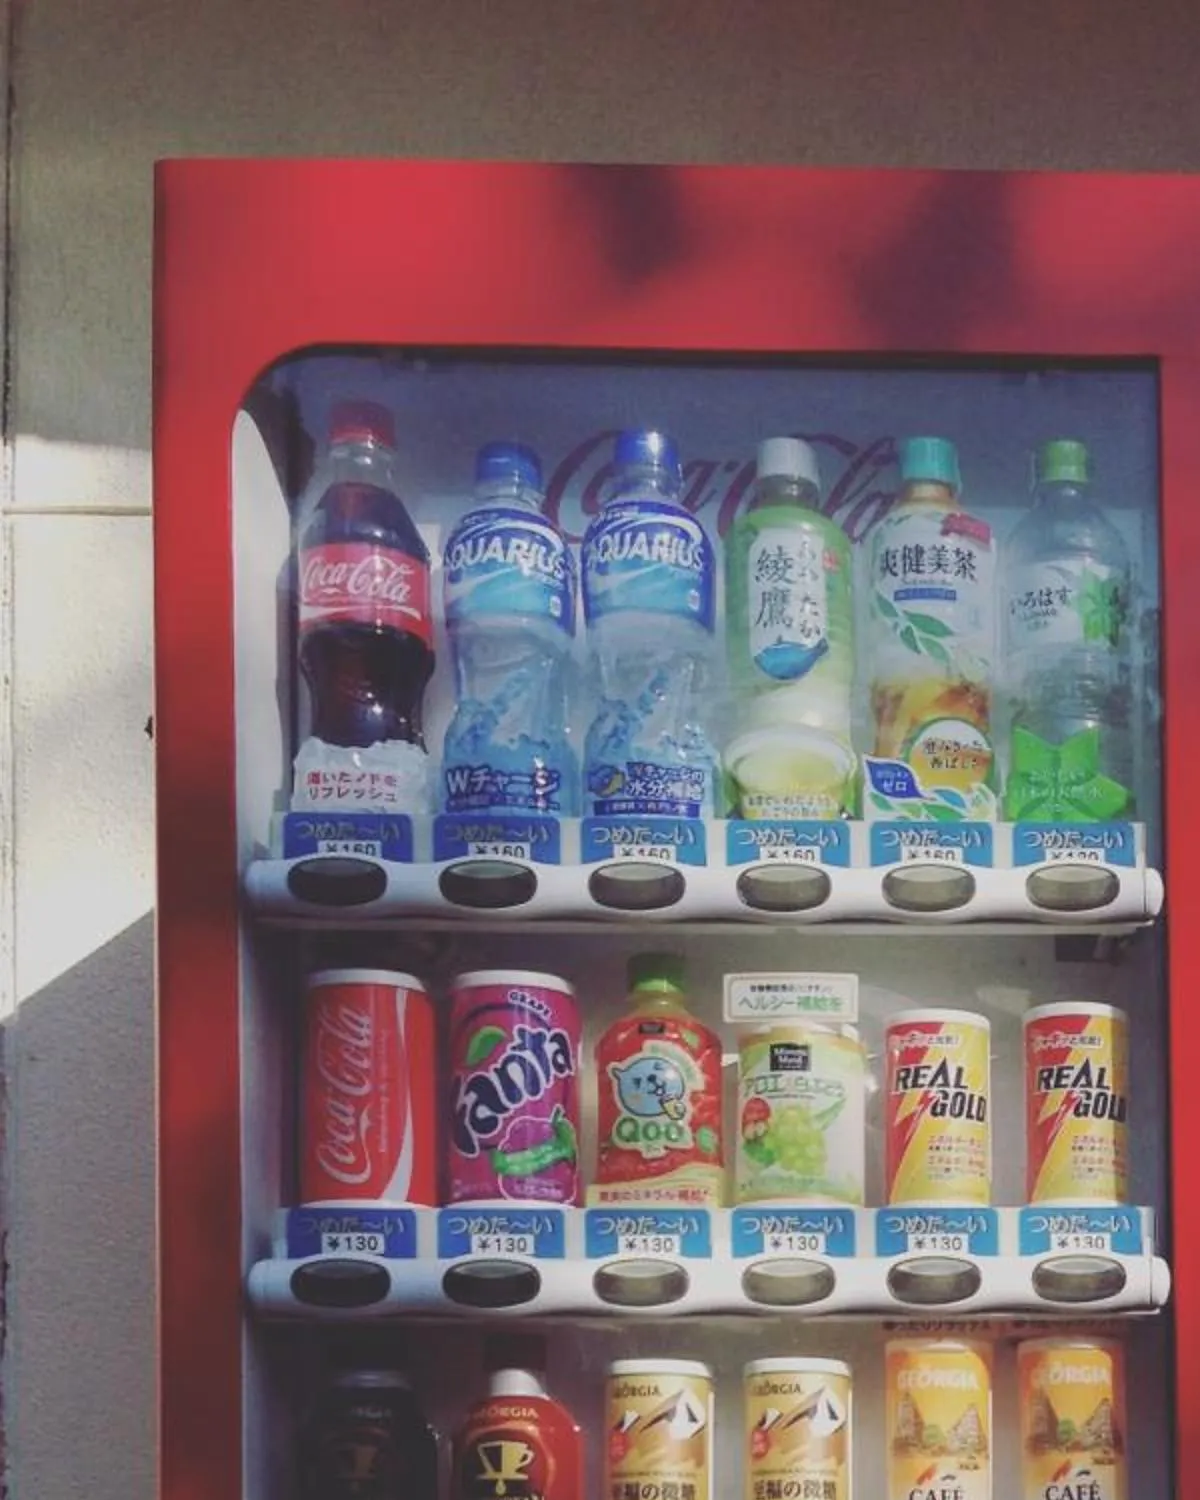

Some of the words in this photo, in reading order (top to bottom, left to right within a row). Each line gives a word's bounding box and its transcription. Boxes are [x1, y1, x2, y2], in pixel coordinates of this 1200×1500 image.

[302, 554, 415, 602] Coca-Cola
[880, 543, 978, 582] 爽健美茶
[754, 545, 796, 629] 綾鷹
[308, 787, 398, 802] リフレッシュ
[447, 764, 561, 797] Wチャージ
[894, 1056, 969, 1090] REAL
[1038, 1056, 1111, 1090] REAL
[316, 1001, 373, 1184] Coca-Cola
[930, 1090, 987, 1122] GOLD
[1074, 1090, 1126, 1123] GOLD
[615, 1117, 685, 1143] Qoo
[326, 1236, 379, 1252] ¥130
[477, 1236, 529, 1252] ¥130
[623, 1236, 675, 1252] ¥130
[769, 1236, 819, 1251] ¥130
[913, 1236, 963, 1251] ¥130
[1056, 1236, 1106, 1250] ¥130
